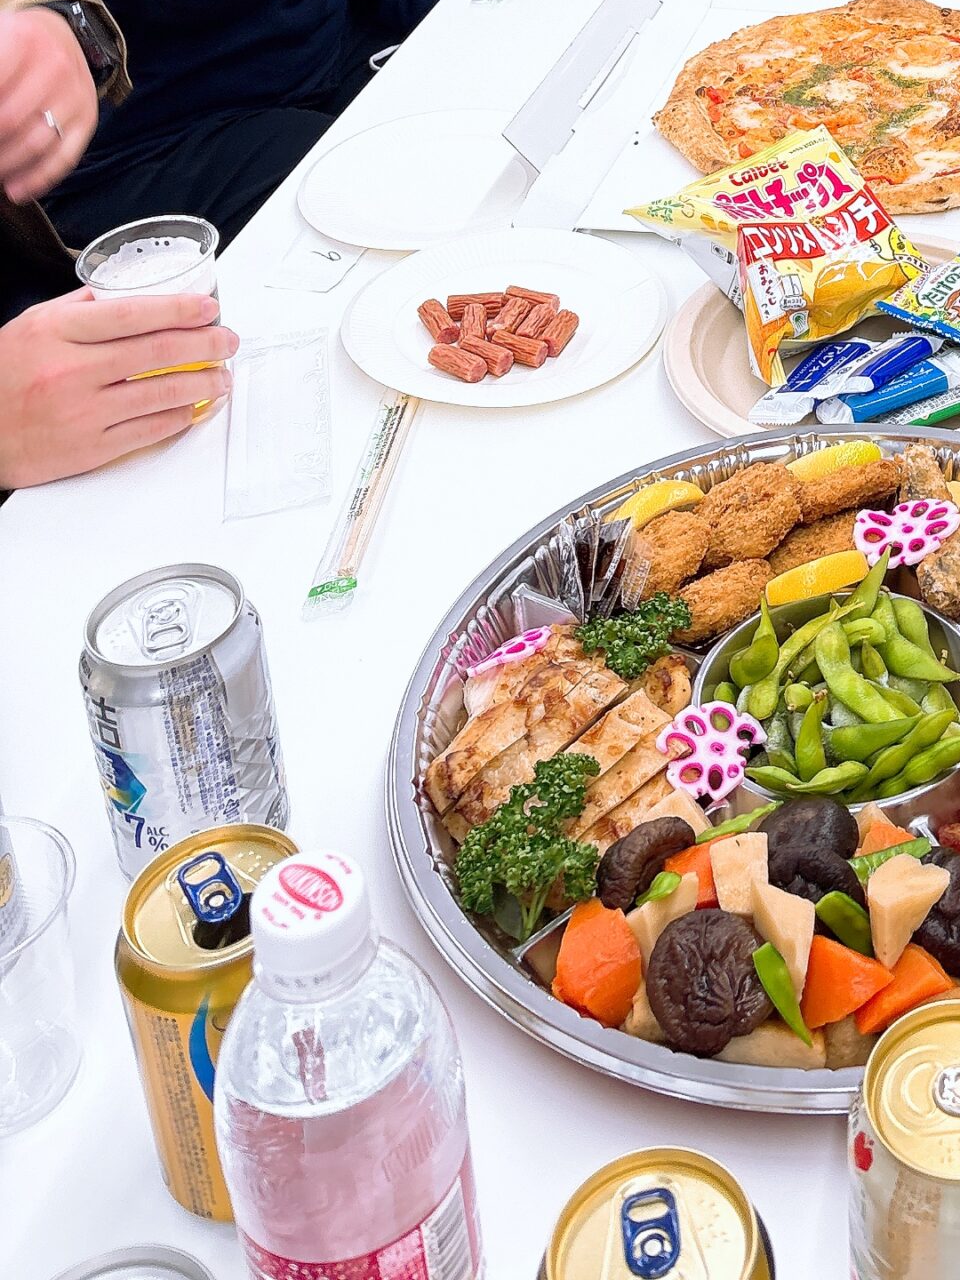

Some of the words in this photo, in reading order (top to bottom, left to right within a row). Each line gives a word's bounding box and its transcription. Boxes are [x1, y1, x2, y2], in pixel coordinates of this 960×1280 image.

[712, 162, 854, 220] ポテトチップス
[728, 161, 789, 187] Calbee
[742, 196, 880, 260] コンソメパンチ
[758, 264, 777, 306] おみくじ
[124, 812, 145, 849] 7
